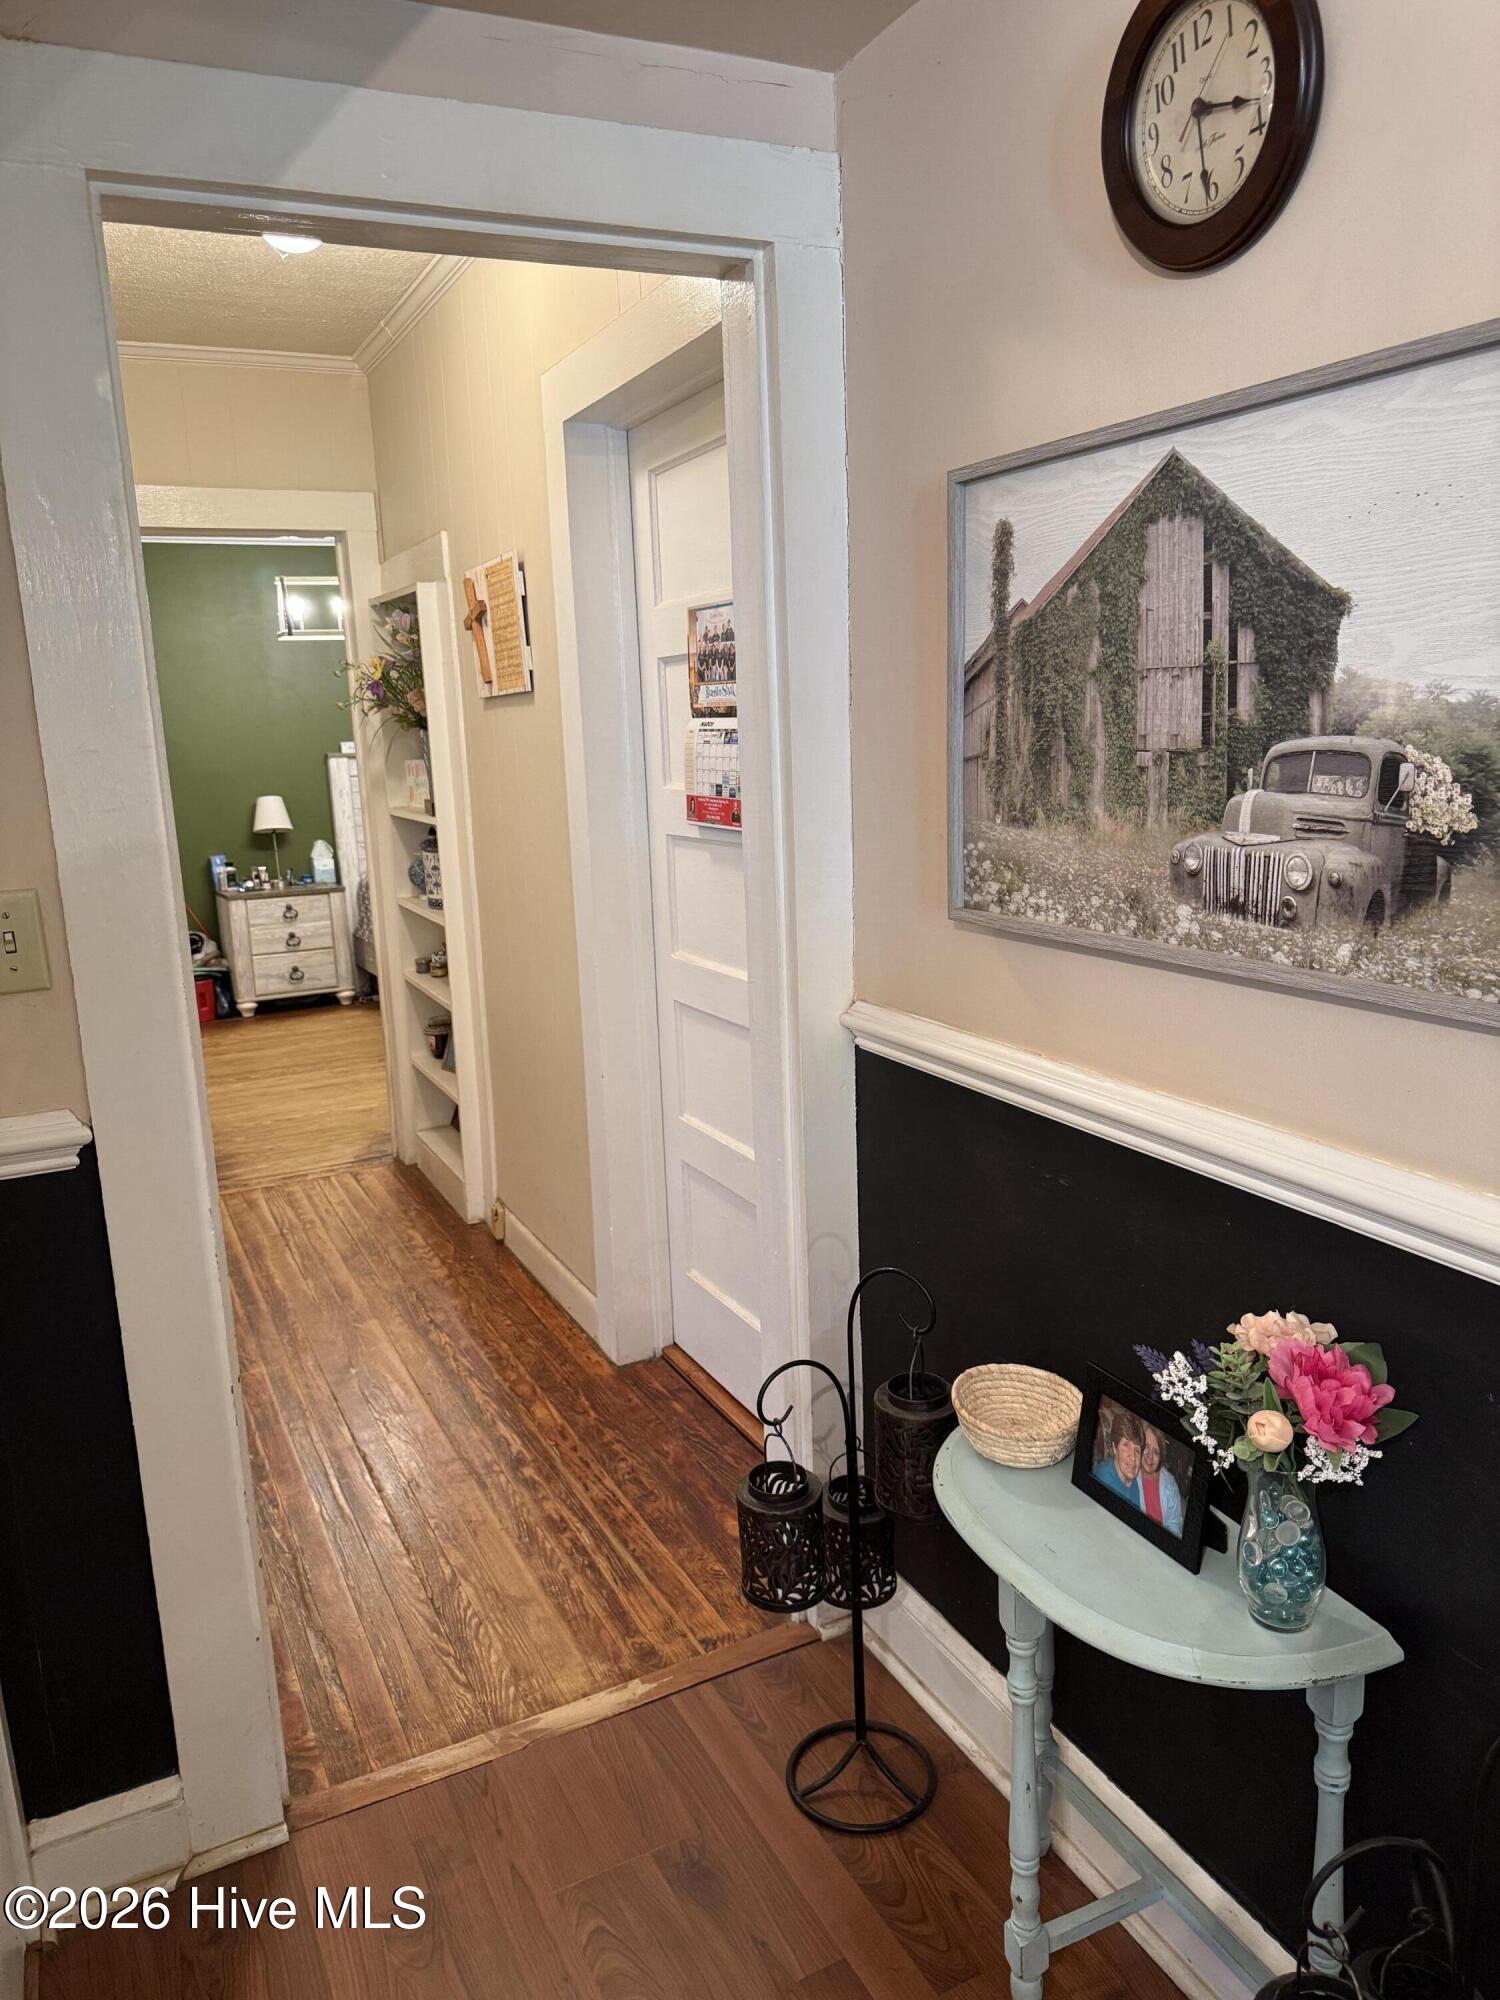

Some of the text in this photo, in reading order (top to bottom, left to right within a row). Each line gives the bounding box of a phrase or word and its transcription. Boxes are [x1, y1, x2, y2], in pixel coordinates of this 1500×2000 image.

[1192, 9, 1213, 51] 12
[1227, 4, 1233, 37] 1
[1171, 32, 1186, 73] 11
[1244, 18, 1260, 59] 2
[1261, 56, 1273, 96] 3
[1154, 74, 1175, 114] 10
[1248, 103, 1267, 136] 4
[1148, 122, 1159, 156] 9
[1160, 154, 1173, 188] 8
[1234, 144, 1245, 181] 5
[1182, 172, 1193, 203] 7
[1206, 168, 1219, 202] 6
